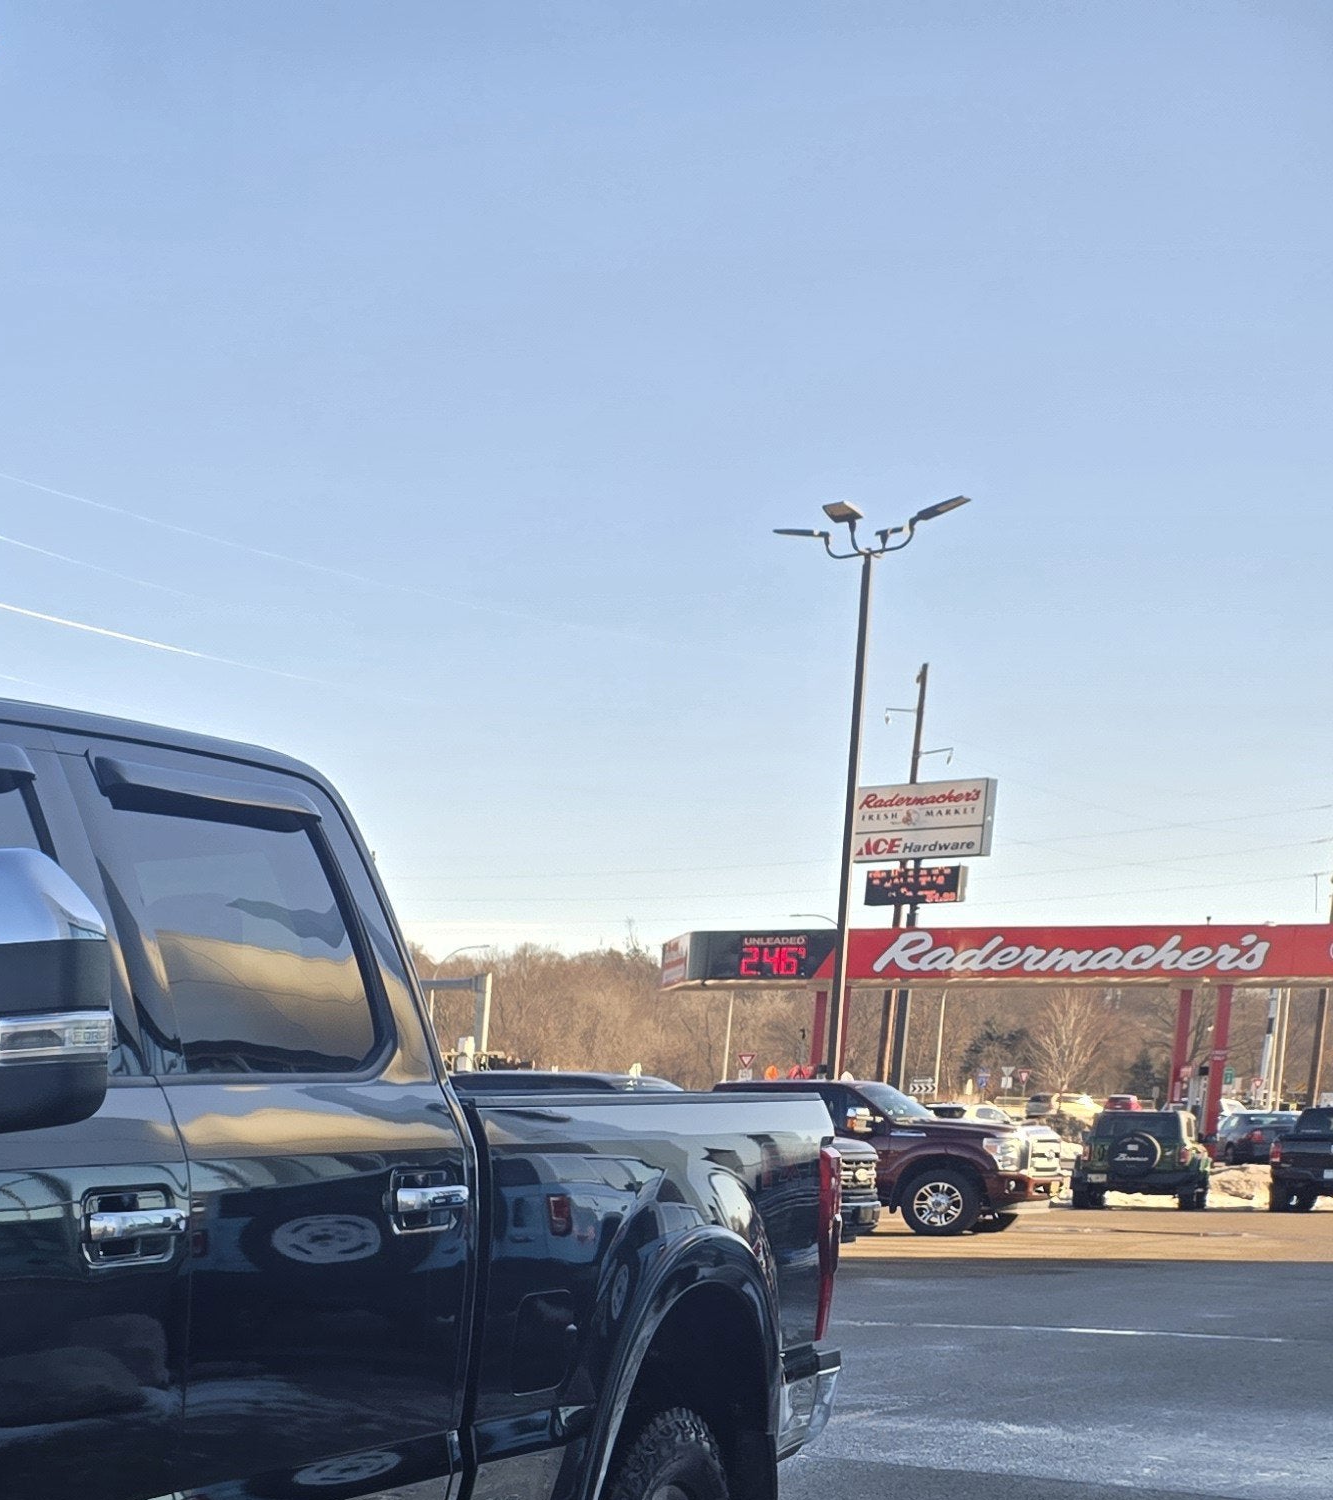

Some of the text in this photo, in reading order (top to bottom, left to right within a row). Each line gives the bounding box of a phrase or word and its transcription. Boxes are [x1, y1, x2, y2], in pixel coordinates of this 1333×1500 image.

[859, 789, 981, 810] Radermacher's
[861, 806, 976, 821] FRESH MARKET
[856, 837, 975, 856] ACE Hardware
[744, 936, 806, 945] UNLEADED
[873, 930, 1271, 973] Radermacher's
